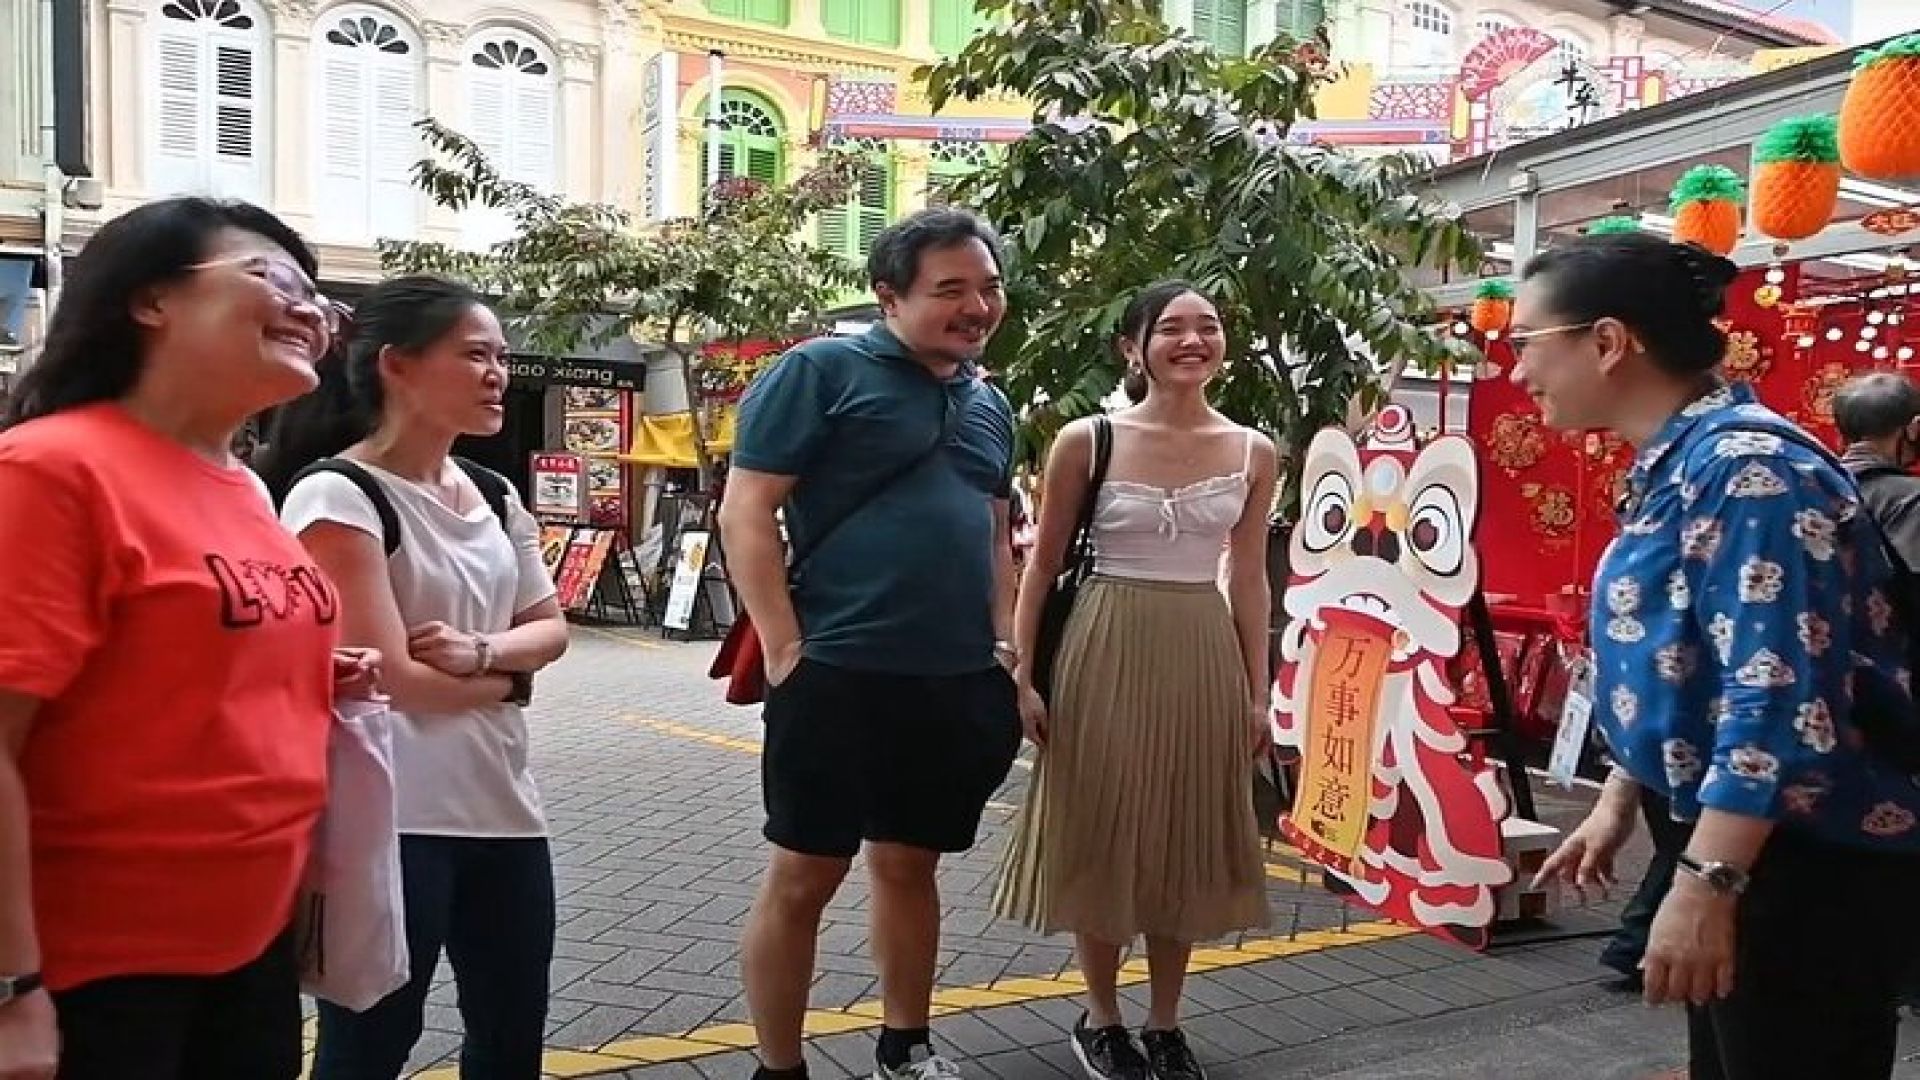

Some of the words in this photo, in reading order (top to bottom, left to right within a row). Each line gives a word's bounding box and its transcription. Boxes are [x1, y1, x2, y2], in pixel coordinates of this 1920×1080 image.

[552, 362, 613, 386] xiang
[1312, 636, 1371, 822] 万事如意
